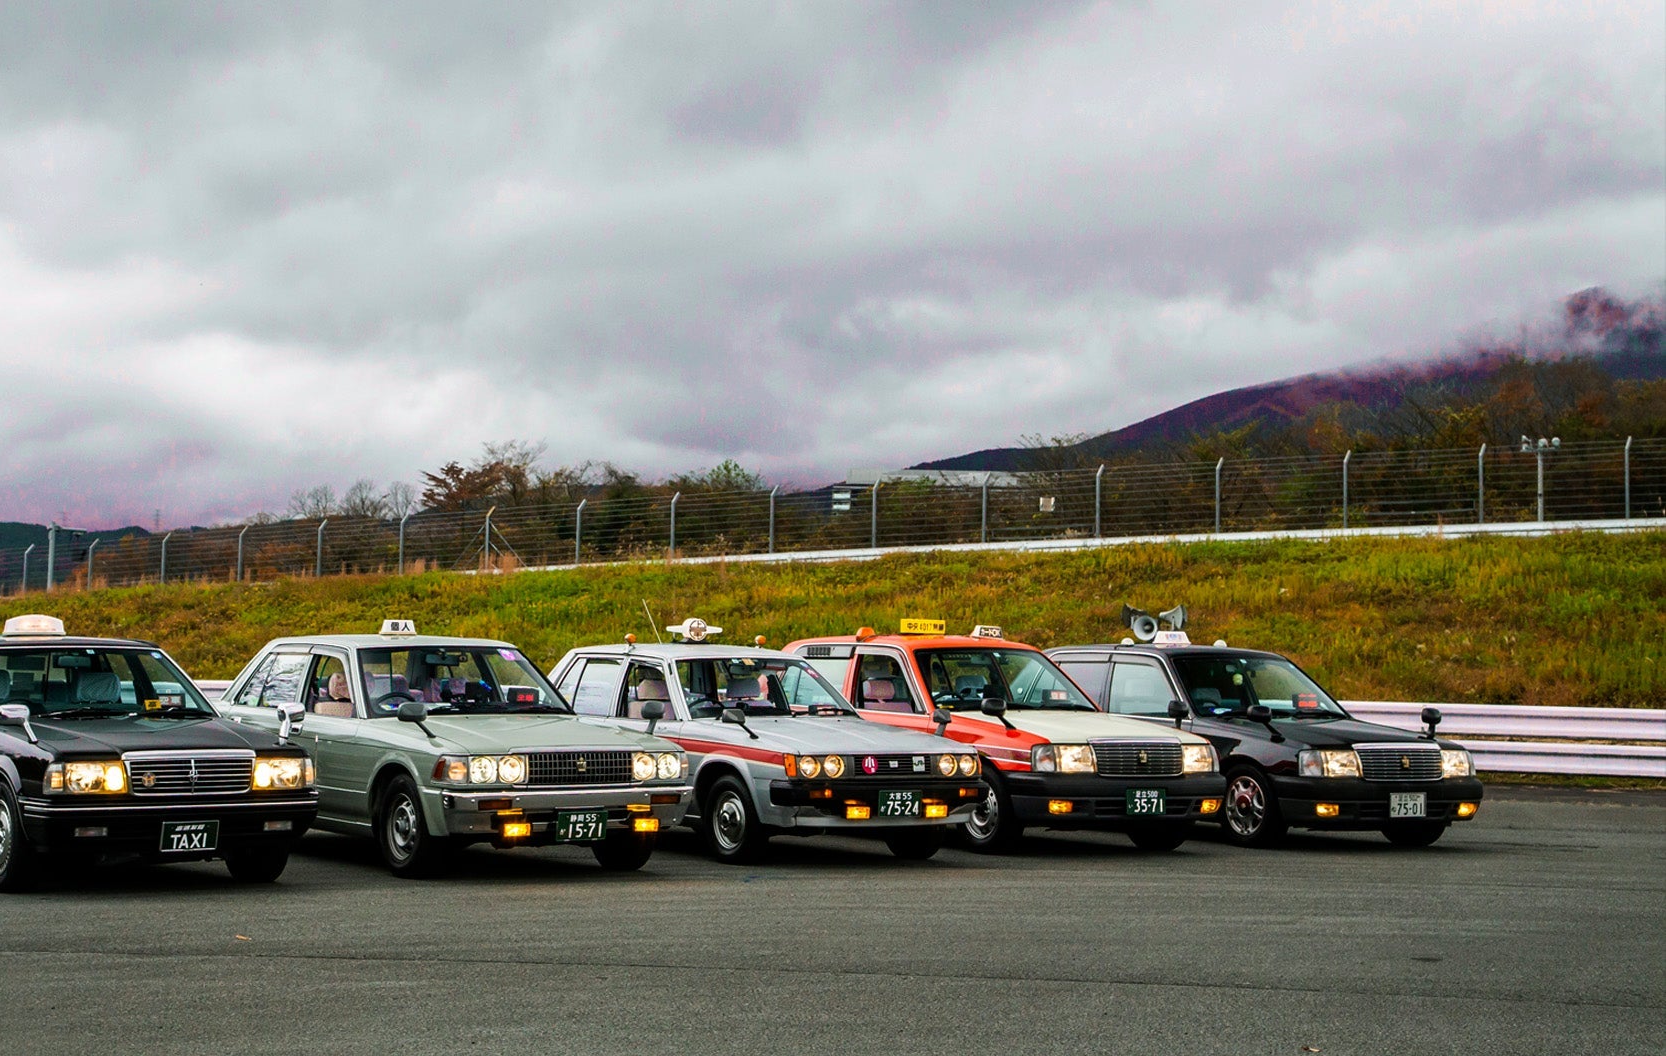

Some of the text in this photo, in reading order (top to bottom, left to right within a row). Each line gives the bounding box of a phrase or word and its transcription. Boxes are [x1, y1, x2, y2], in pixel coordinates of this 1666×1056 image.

[391, 621, 410, 631] 個人
[889, 792, 912, 800] 大宮 55
[1147, 790, 1158, 798] 500
[887, 801, 919, 815] 75-24
[1134, 798, 1163, 812] 35-71
[1397, 802, 1423, 815] 75-01
[570, 813, 597, 822] 静岡 55
[568, 822, 603, 838] 15-71
[170, 832, 207, 849] TAXI
